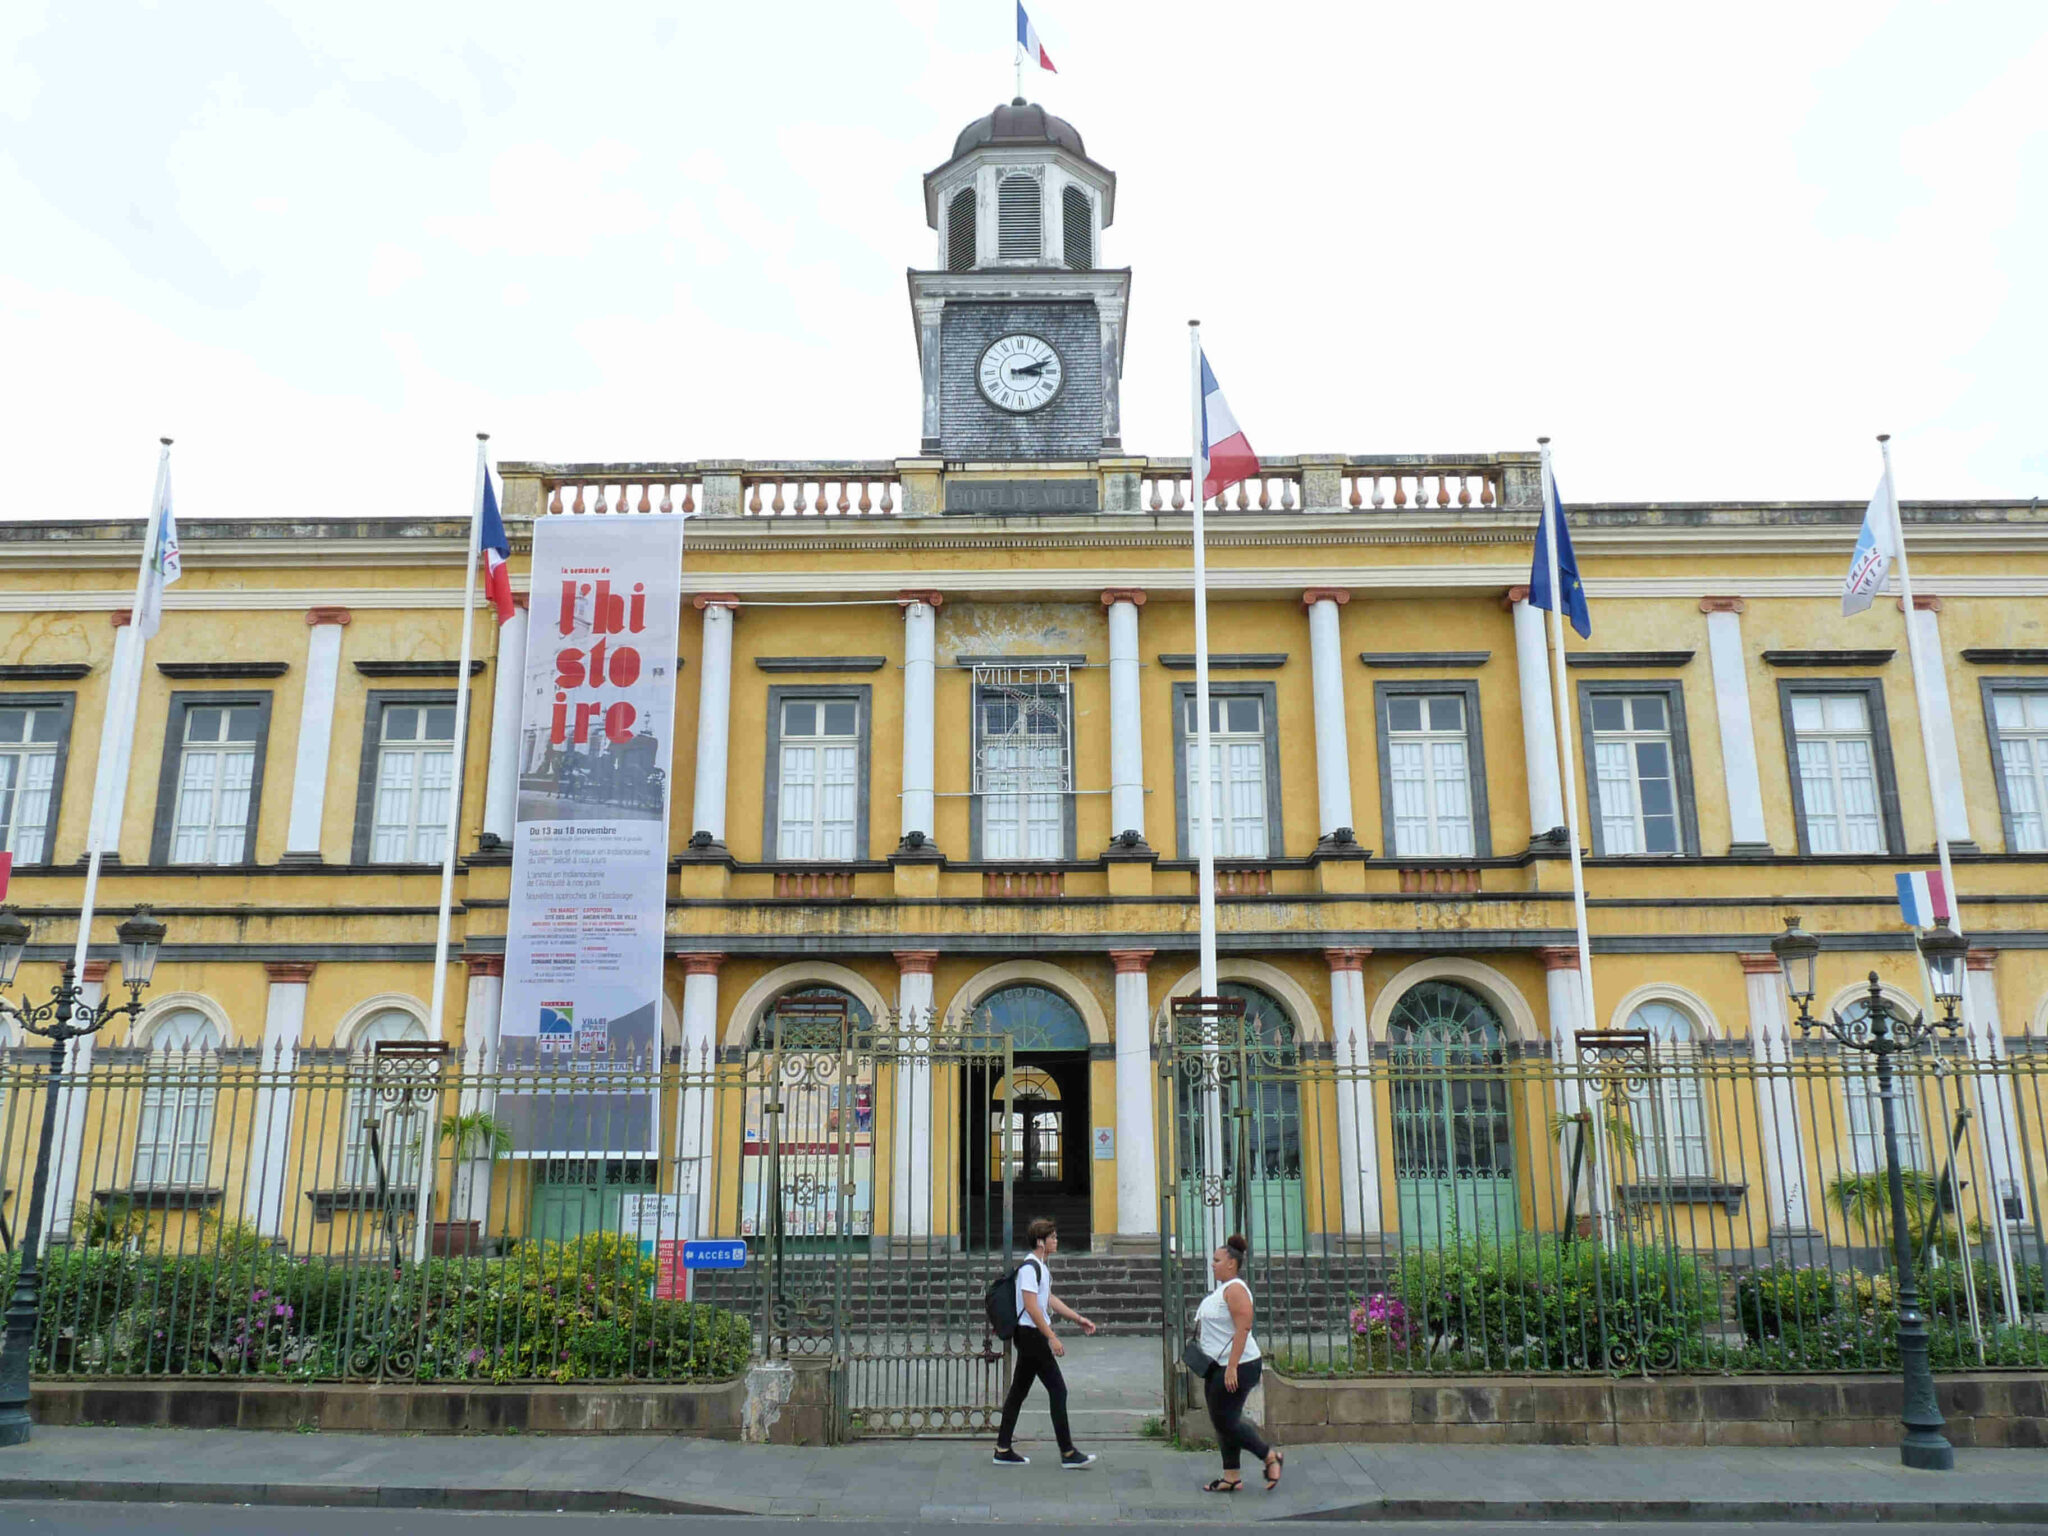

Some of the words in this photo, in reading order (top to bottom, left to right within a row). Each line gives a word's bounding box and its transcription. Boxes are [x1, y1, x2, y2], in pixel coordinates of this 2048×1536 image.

[1044, 487, 1092, 505] VILLE
[554, 636, 641, 689] sto
[976, 668, 1035, 685] VILLE
[1039, 668, 1066, 684] DE
[550, 691, 637, 745] ire
[530, 827, 540, 835] Du
[542, 827, 551, 835] 13
[553, 827, 563, 835] au
[565, 827, 575, 835] 18
[576, 826, 616, 835] novembre
[698, 1249, 731, 1260] ACCÈS
